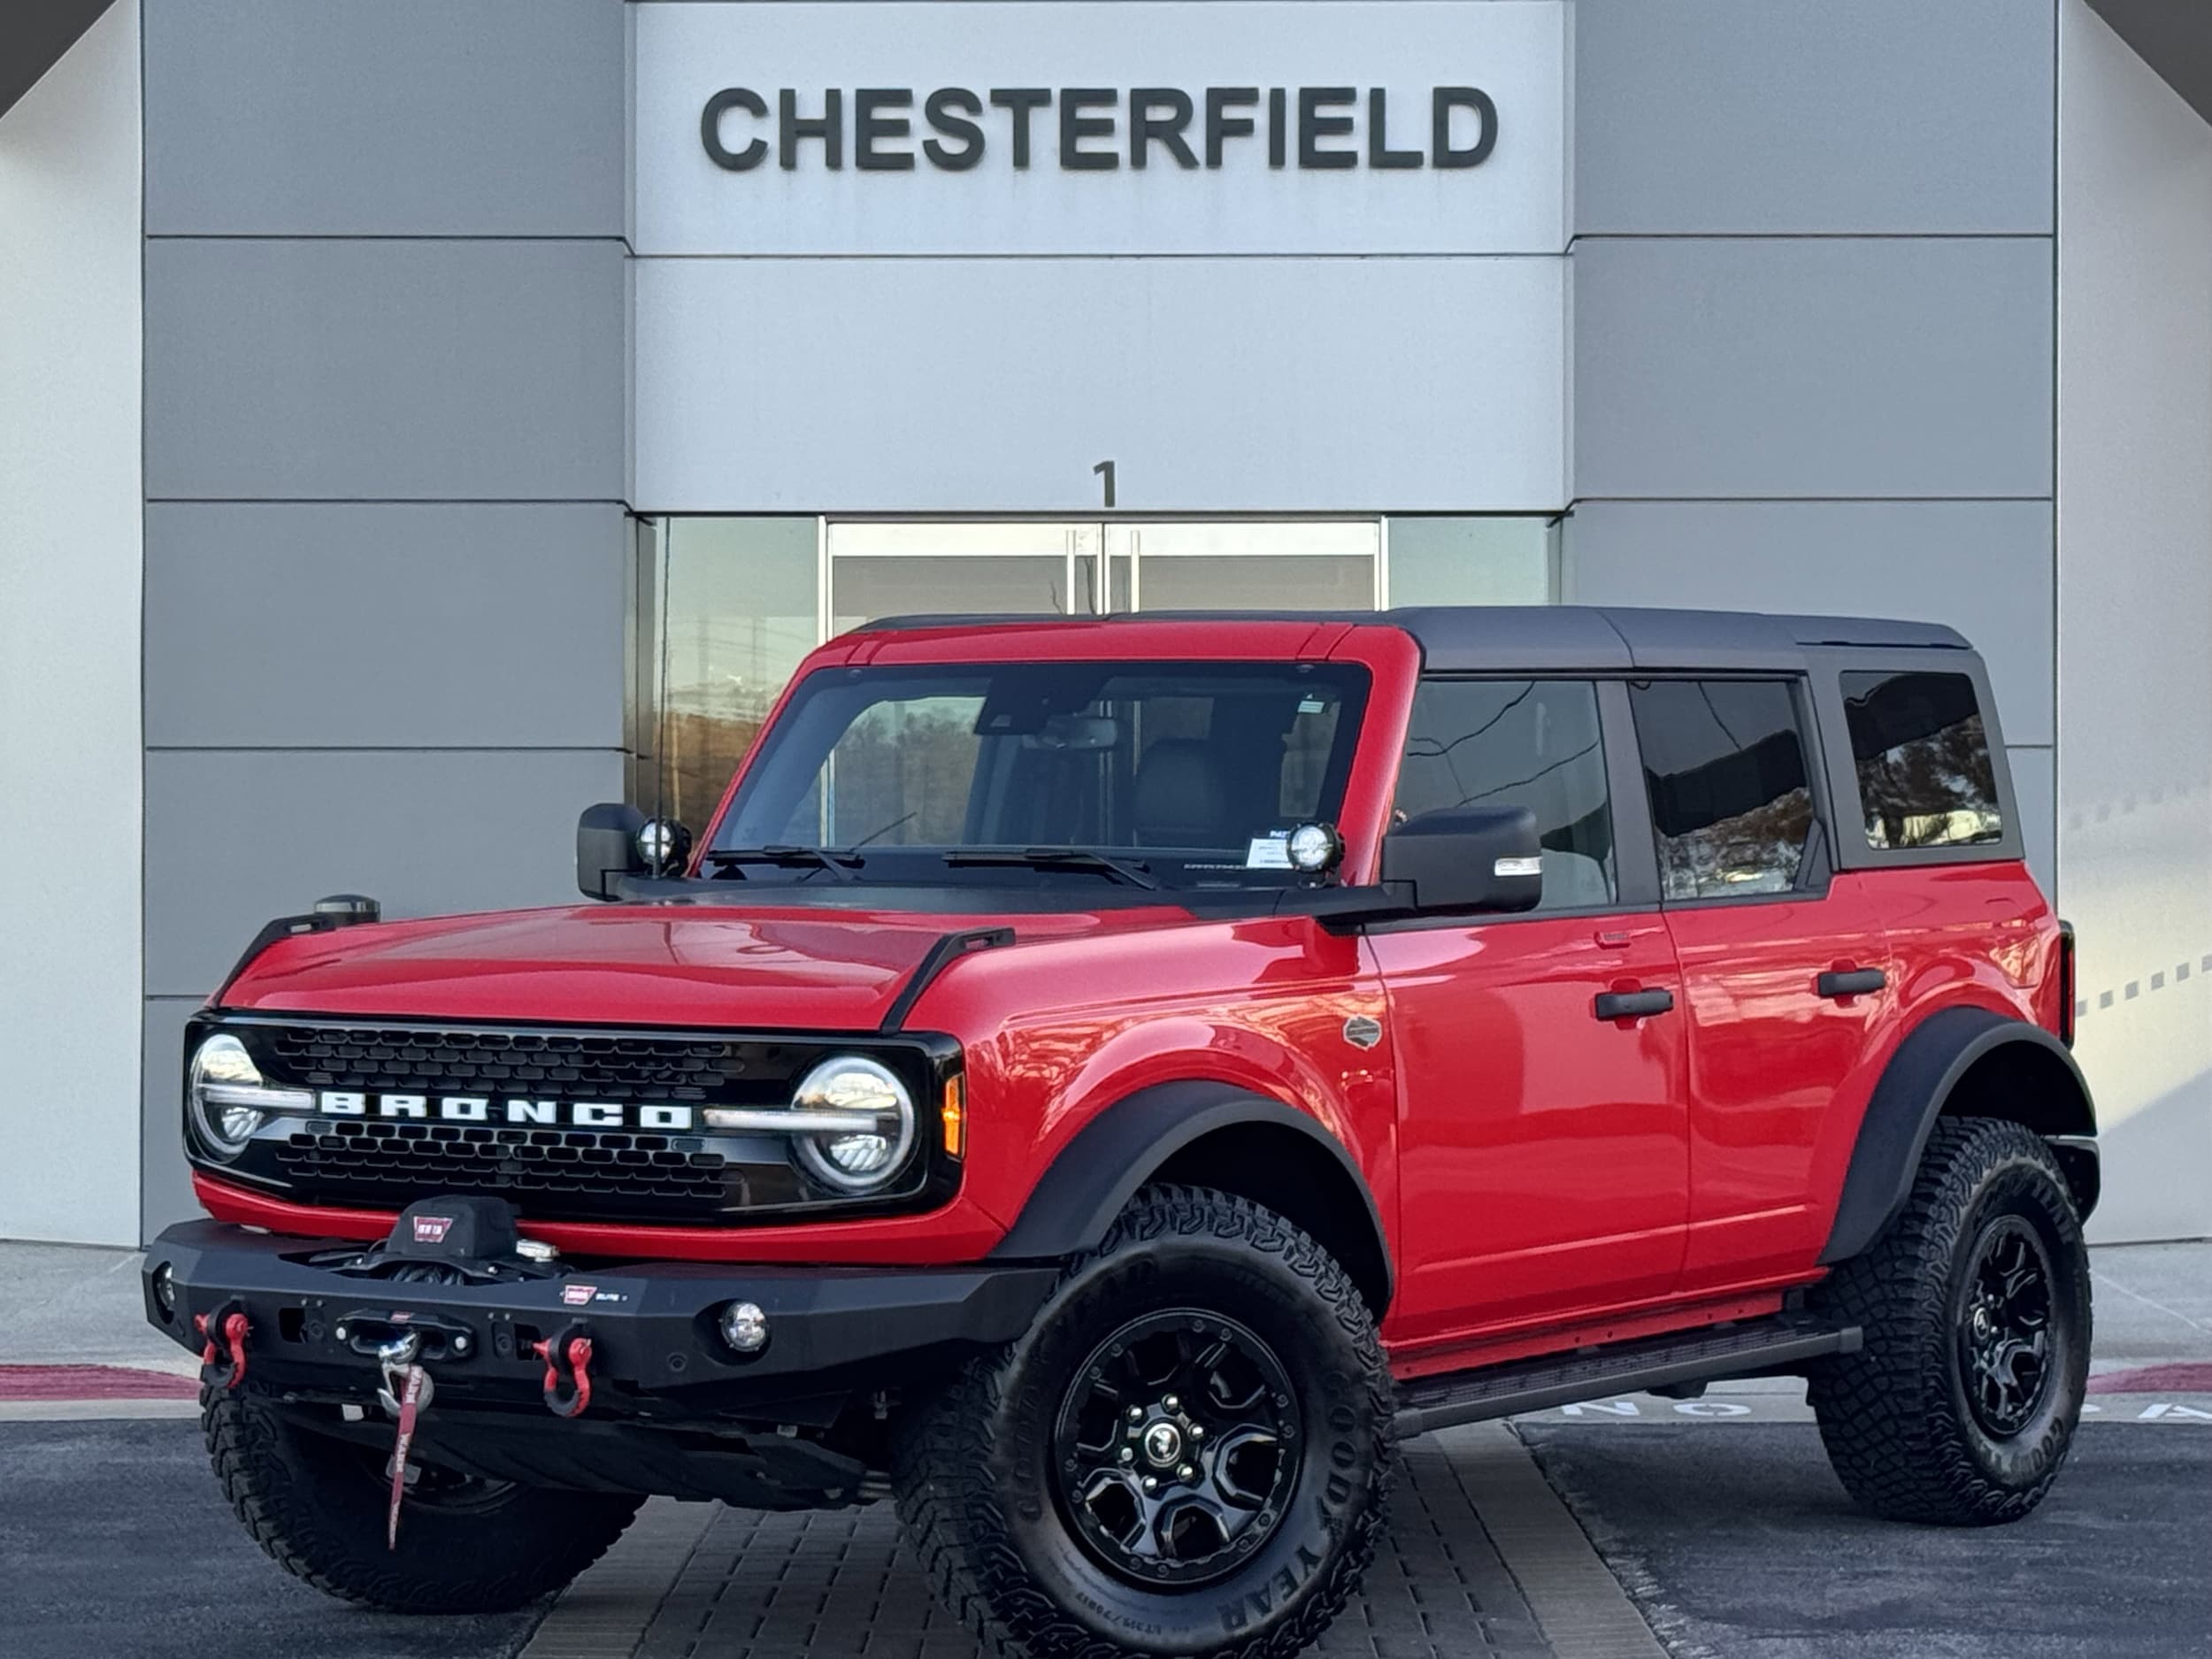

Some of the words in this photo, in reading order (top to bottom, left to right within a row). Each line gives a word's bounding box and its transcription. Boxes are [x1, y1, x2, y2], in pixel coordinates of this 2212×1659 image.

[701, 87, 1498, 171] CHESTERFIELD
[1093, 461, 1116, 508] 1
[321, 1091, 693, 1129] BRONCO
[1561, 1402, 1752, 1417] NO
